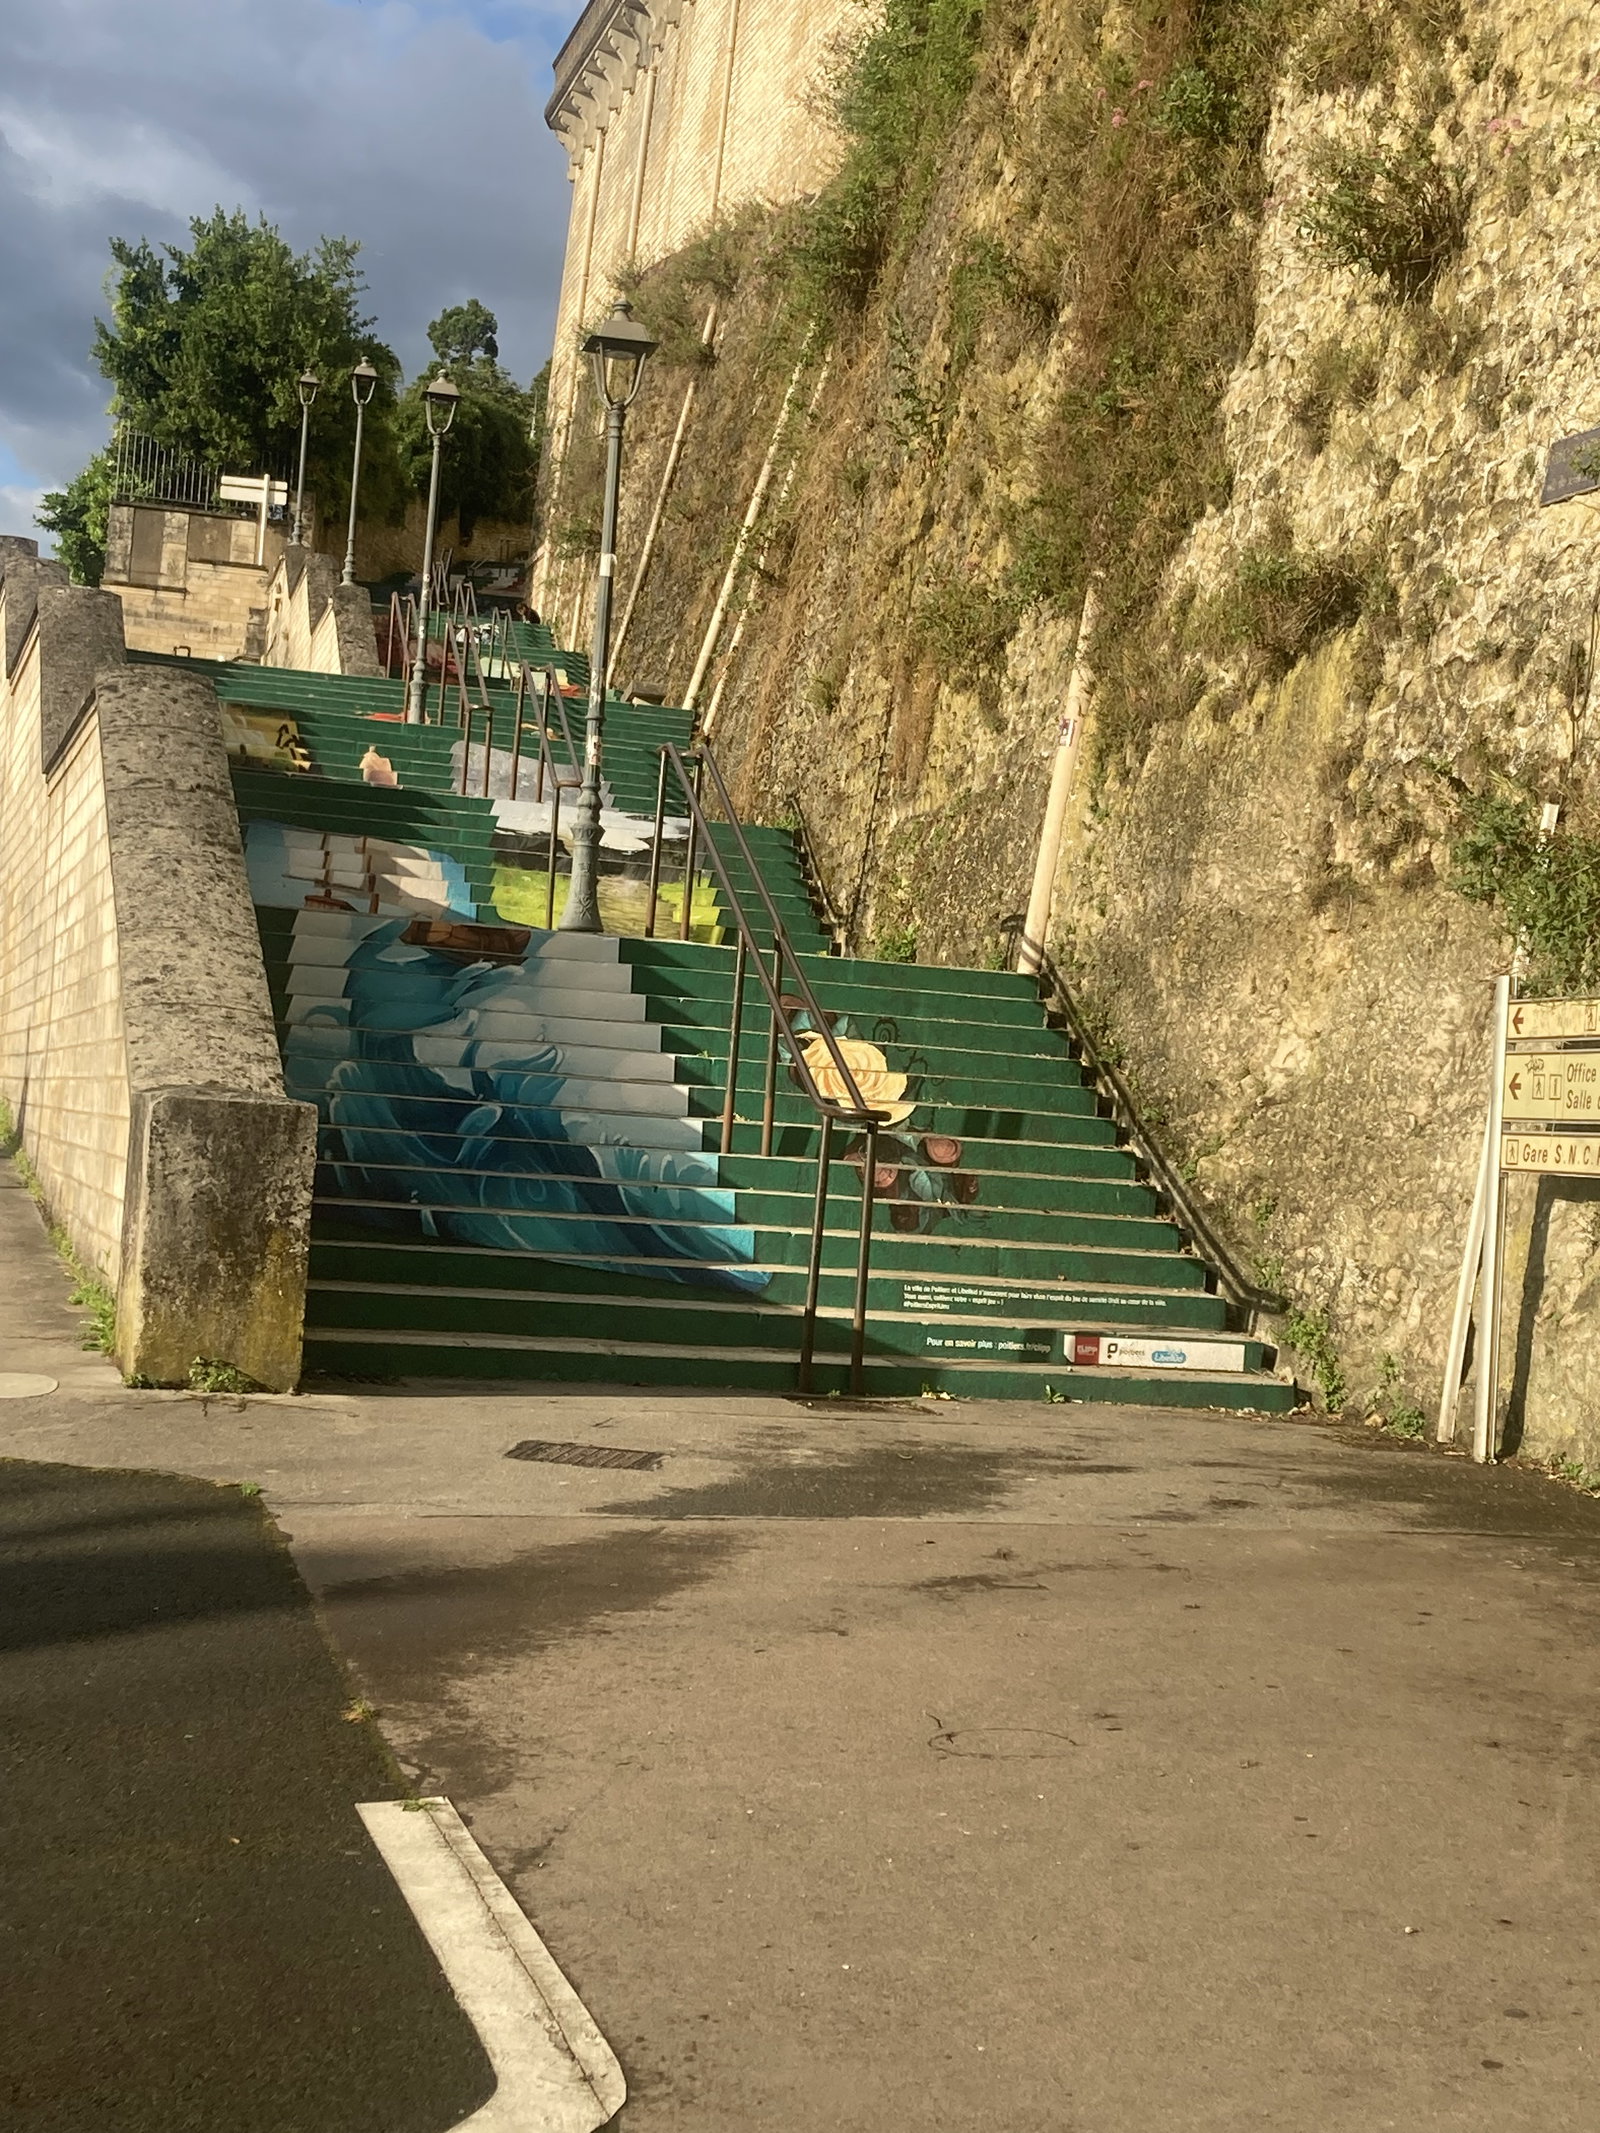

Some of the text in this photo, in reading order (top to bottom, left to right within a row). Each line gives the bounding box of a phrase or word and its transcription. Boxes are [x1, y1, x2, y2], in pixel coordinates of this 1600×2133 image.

[1566, 1063, 1597, 1083] Office
[1566, 1090, 1592, 1110] Salle
[1522, 1144, 1549, 1164] Gare
[926, 1337, 943, 1347] Pour
[944, 1339, 954, 1347] en
[955, 1339, 977, 1348] savoir
[977, 1340, 993, 1349] plus
